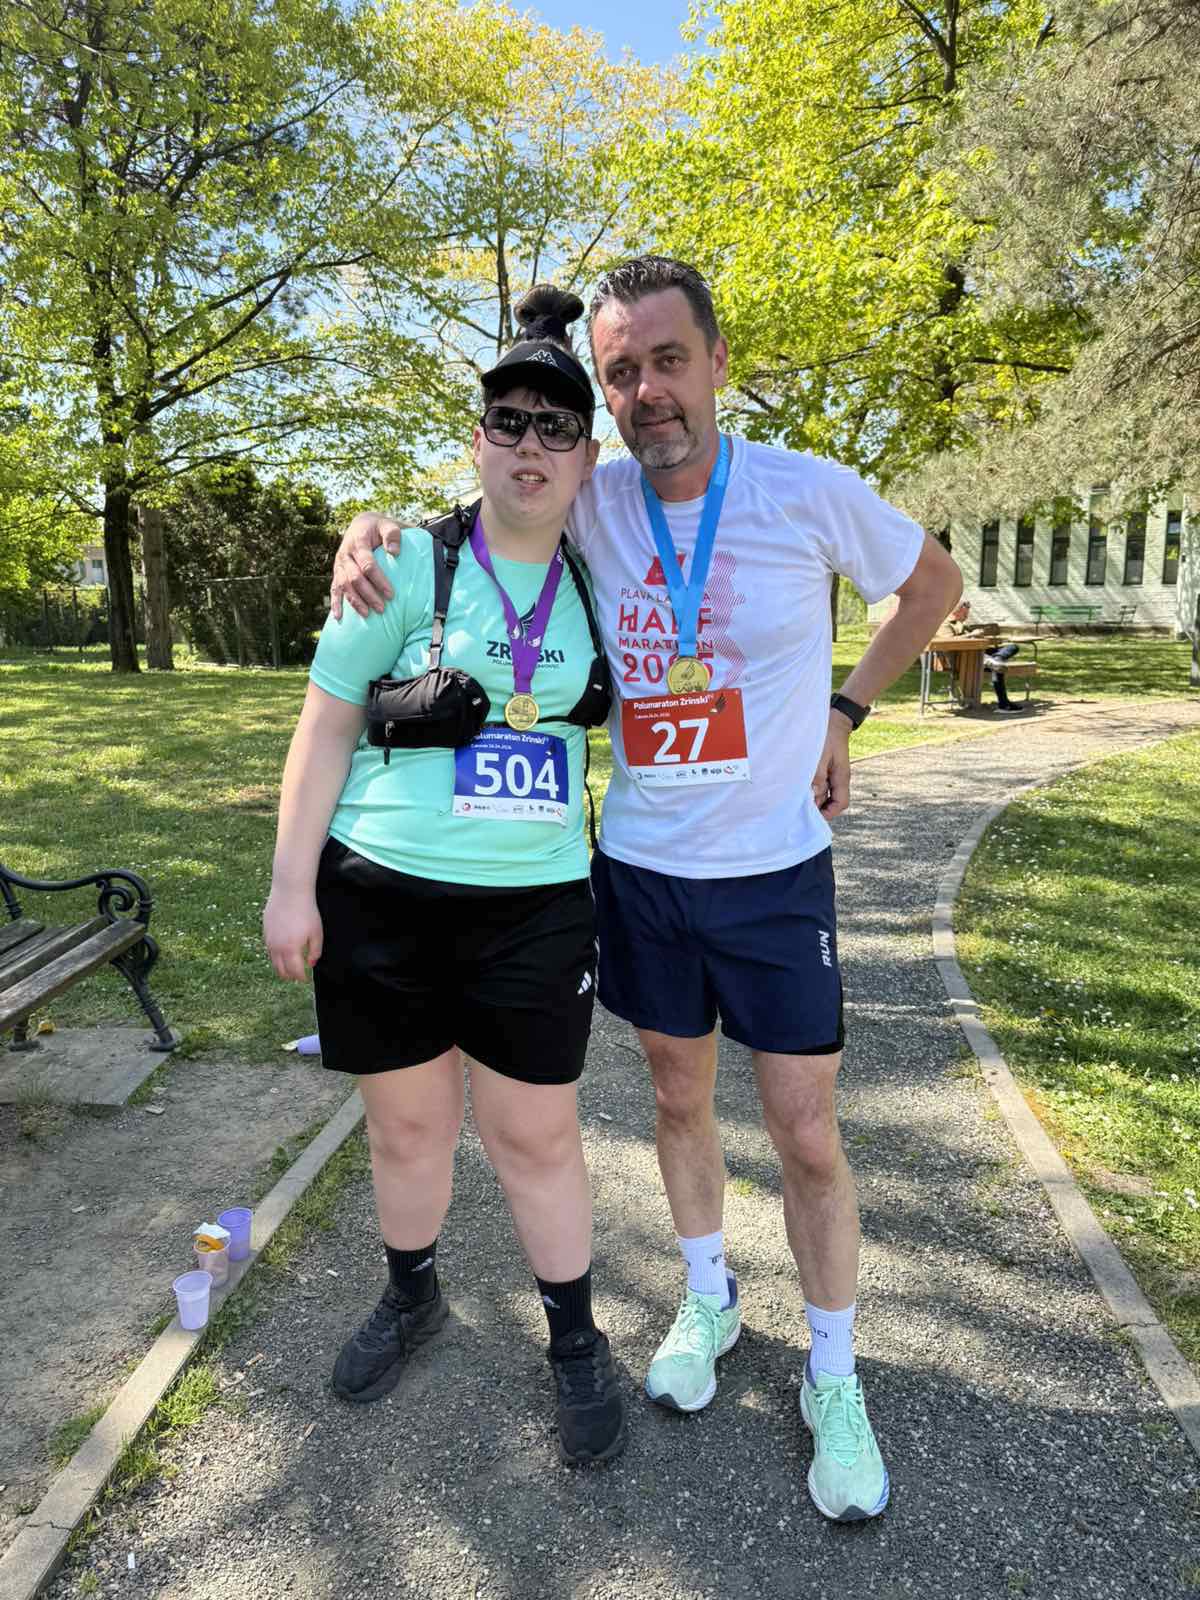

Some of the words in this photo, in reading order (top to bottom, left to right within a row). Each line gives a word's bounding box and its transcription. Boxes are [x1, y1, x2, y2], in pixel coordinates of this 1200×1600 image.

[486, 640, 565, 663] ZRSKI
[623, 652, 714, 684] 205
[633, 697, 679, 710] Polumaraton
[473, 732, 521, 742] olumaraton
[650, 717, 709, 764] 27
[474, 752, 559, 799] 504
[818, 930, 832, 967] RUN
